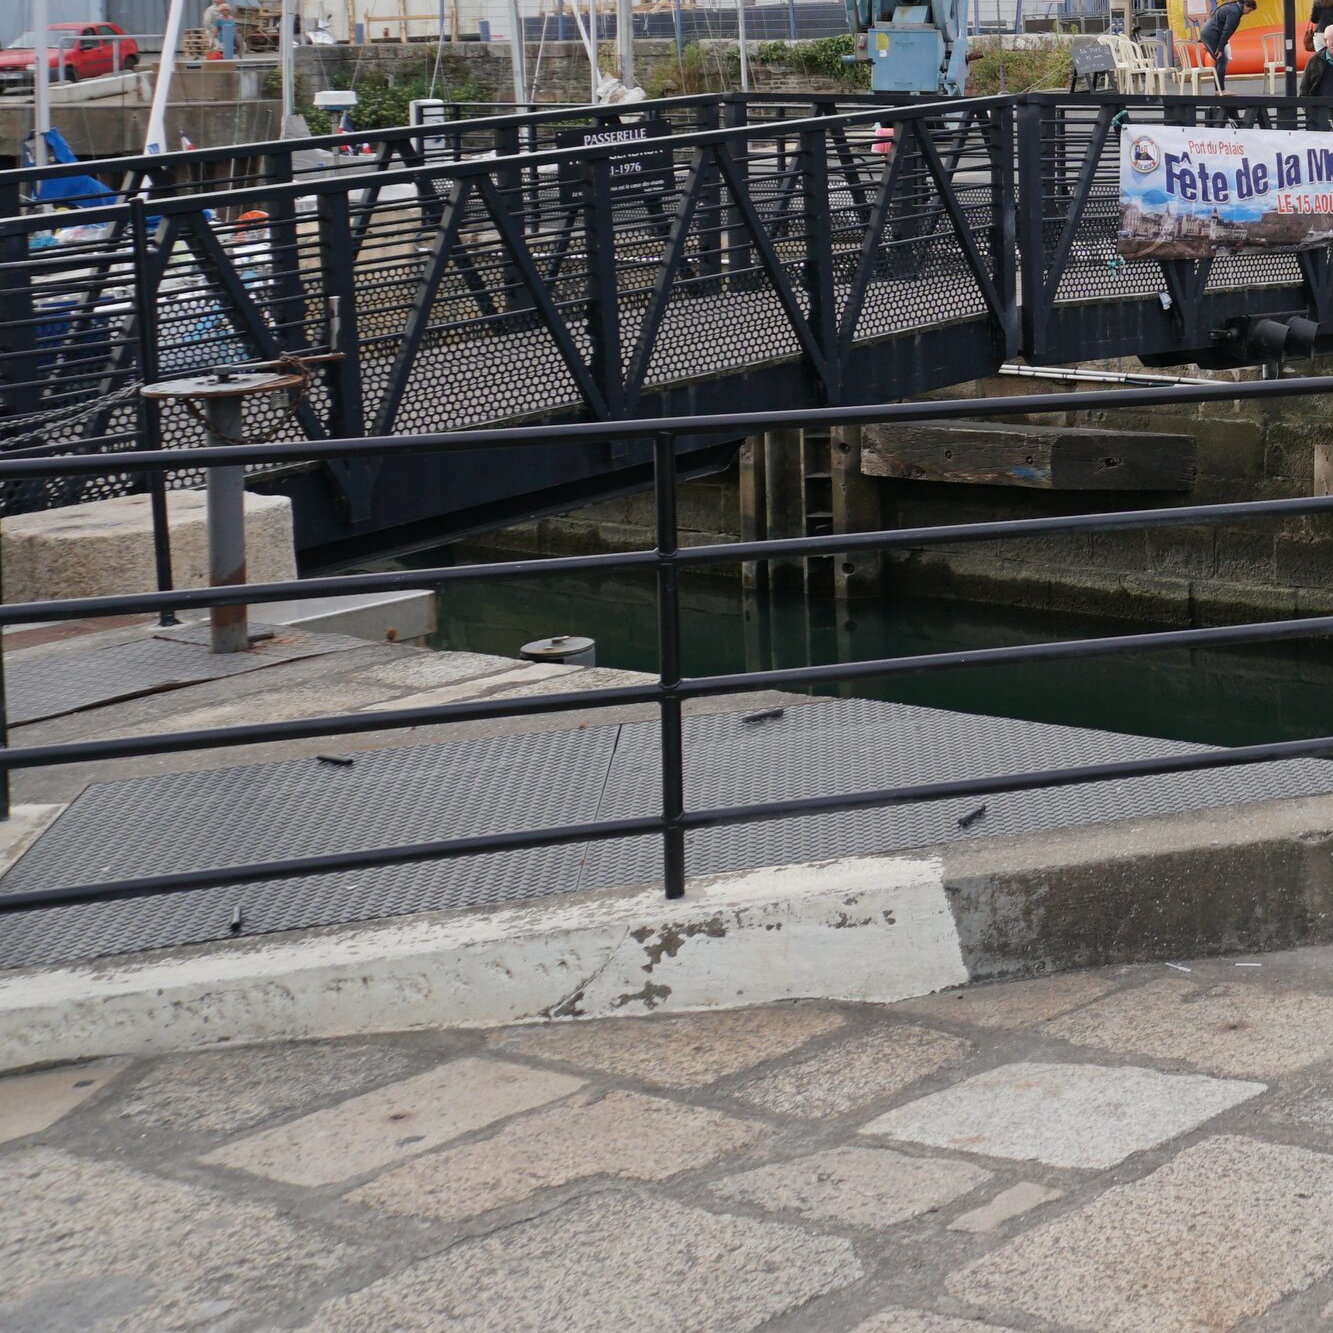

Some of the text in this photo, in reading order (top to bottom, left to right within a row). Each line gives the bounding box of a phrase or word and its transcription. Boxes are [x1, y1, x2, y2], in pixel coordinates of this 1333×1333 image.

[583, 127, 647, 146] PASSERELLE
[1188, 140, 1245, 155] Port du Palais
[1164, 150, 1230, 204] Fête
[1235, 156, 1269, 201] de
[1275, 151, 1301, 190] la
[1276, 194, 1292, 214] LE
[1296, 194, 1312, 214] 15
